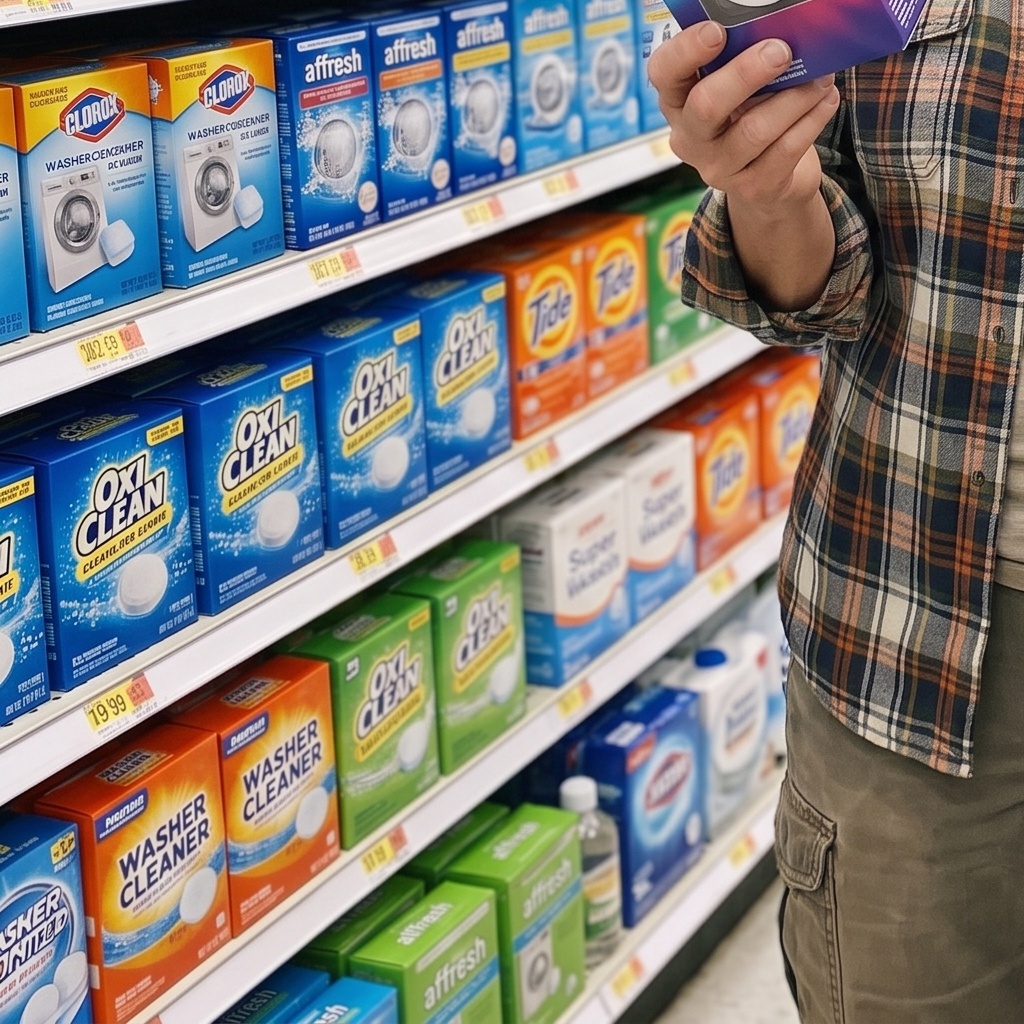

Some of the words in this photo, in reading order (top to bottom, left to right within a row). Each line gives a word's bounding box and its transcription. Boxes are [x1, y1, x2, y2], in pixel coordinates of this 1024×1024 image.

[384, 33, 437, 66] affresh
[457, 17, 505, 49] affresh
[525, 4, 569, 35] affresh
[203, 70, 251, 110] CLOROX
[305, 48, 362, 83] affresh
[65, 93, 121, 137] CLOROX
[595, 259, 638, 315] Tide
[448, 308, 485, 356] OXI
[527, 290, 574, 348] Tide
[354, 352, 397, 402] OXI
[436, 324, 495, 389] CLEAN
[236, 398, 282, 454] OXI
[343, 367, 408, 437] CLEAN
[93, 453, 148, 515] OXI
[222, 415, 298, 493] CLEAN
[76, 471, 167, 557] CLEAN
[456, 597, 510, 674] CLEAN
[357, 656, 422, 741] CLEAN
[370, 643, 408, 701] OXI
[242, 719, 319, 794] WASHER
[243, 741, 323, 823] CLEANER
[118, 793, 207, 881] WASHER
[119, 817, 211, 909] CLEANER
[522, 858, 573, 918] affresh
[423, 937, 487, 1013] affresh
